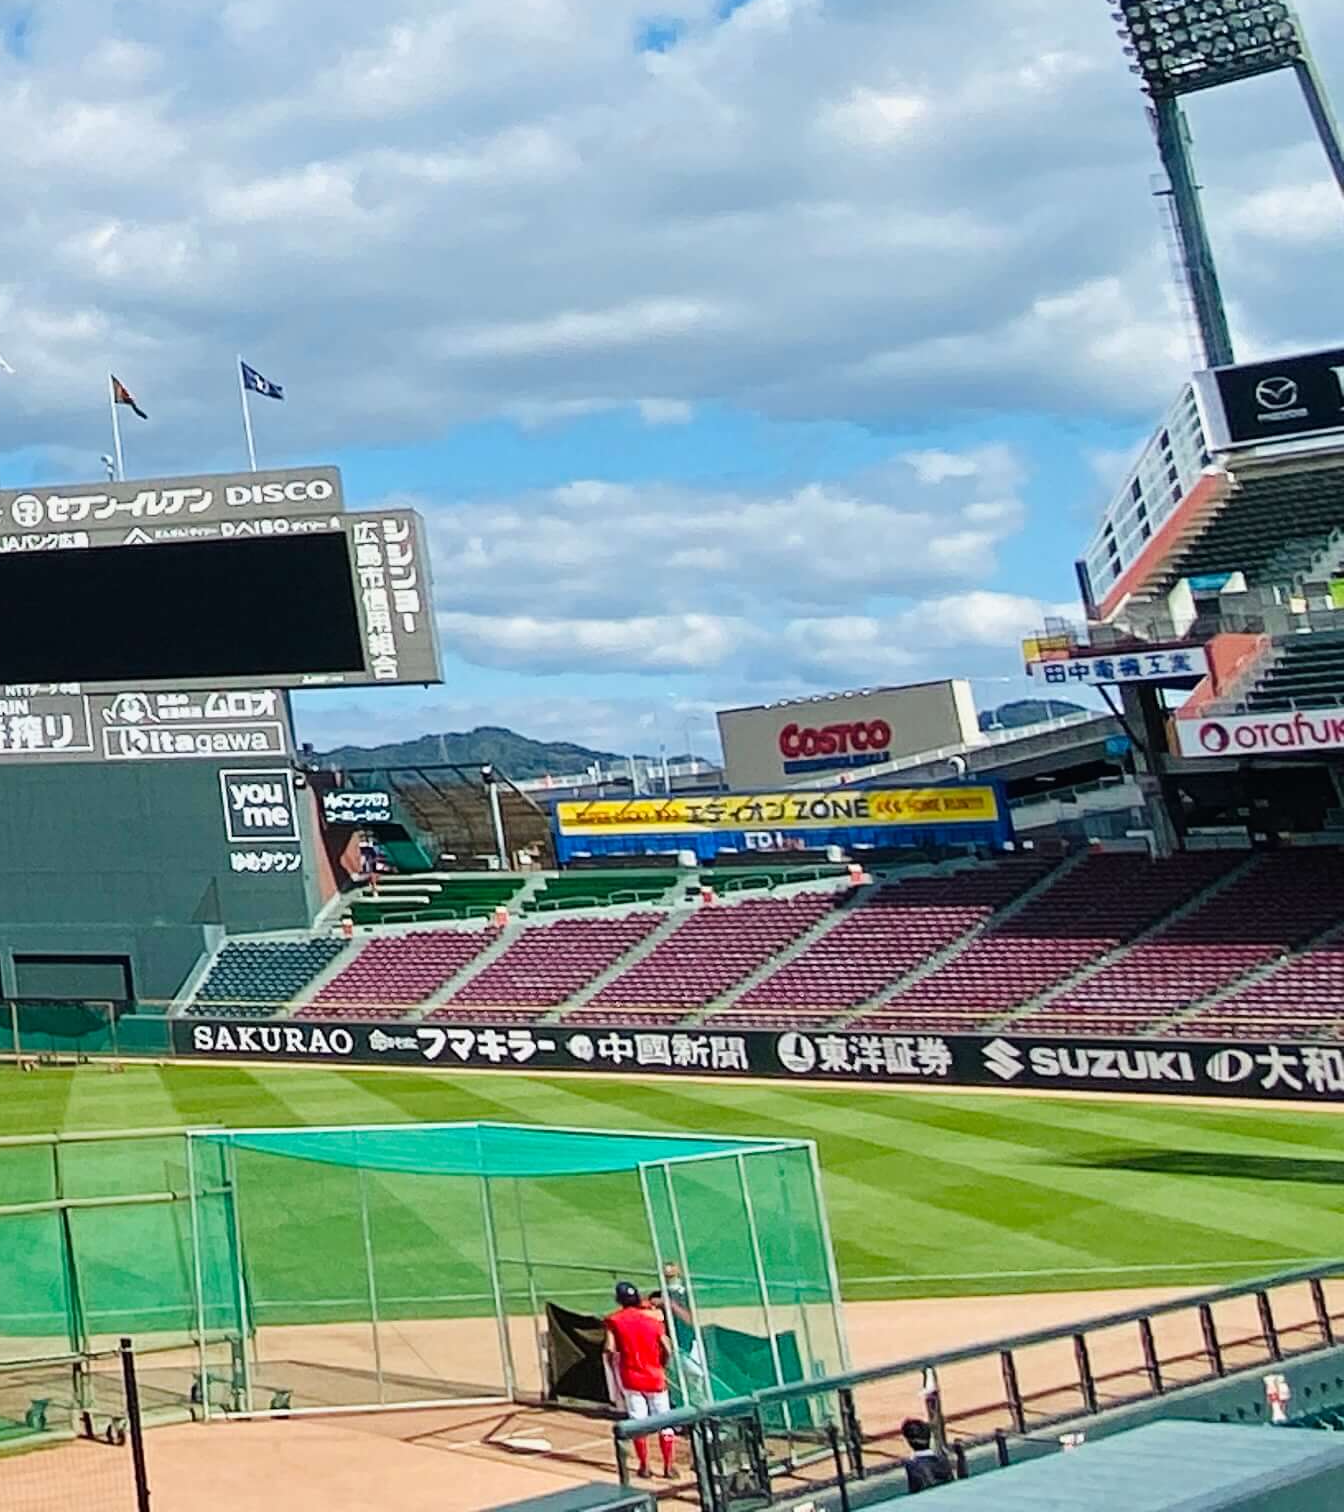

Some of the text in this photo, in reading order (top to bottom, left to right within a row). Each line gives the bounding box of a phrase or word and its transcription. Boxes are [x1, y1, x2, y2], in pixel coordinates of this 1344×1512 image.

[225, 480, 333, 506] DISCO
[383, 518, 420, 633] シシンヨー
[353, 520, 398, 680] 広島市信用組合
[1043, 651, 1193, 684] 田中電機工業
[204, 689, 277, 718] ムロオ
[778, 718, 892, 758] COSTCO
[229, 783, 284, 811] you
[792, 798, 870, 821] ZONE
[243, 804, 290, 828] me
[230, 850, 302, 873] ゆめタウン
[192, 1024, 355, 1055] SAKURAO
[416, 1027, 557, 1063] フマキラー
[814, 1034, 953, 1076] 東洋証券
[1028, 1046, 1196, 1082] SUZUKI
